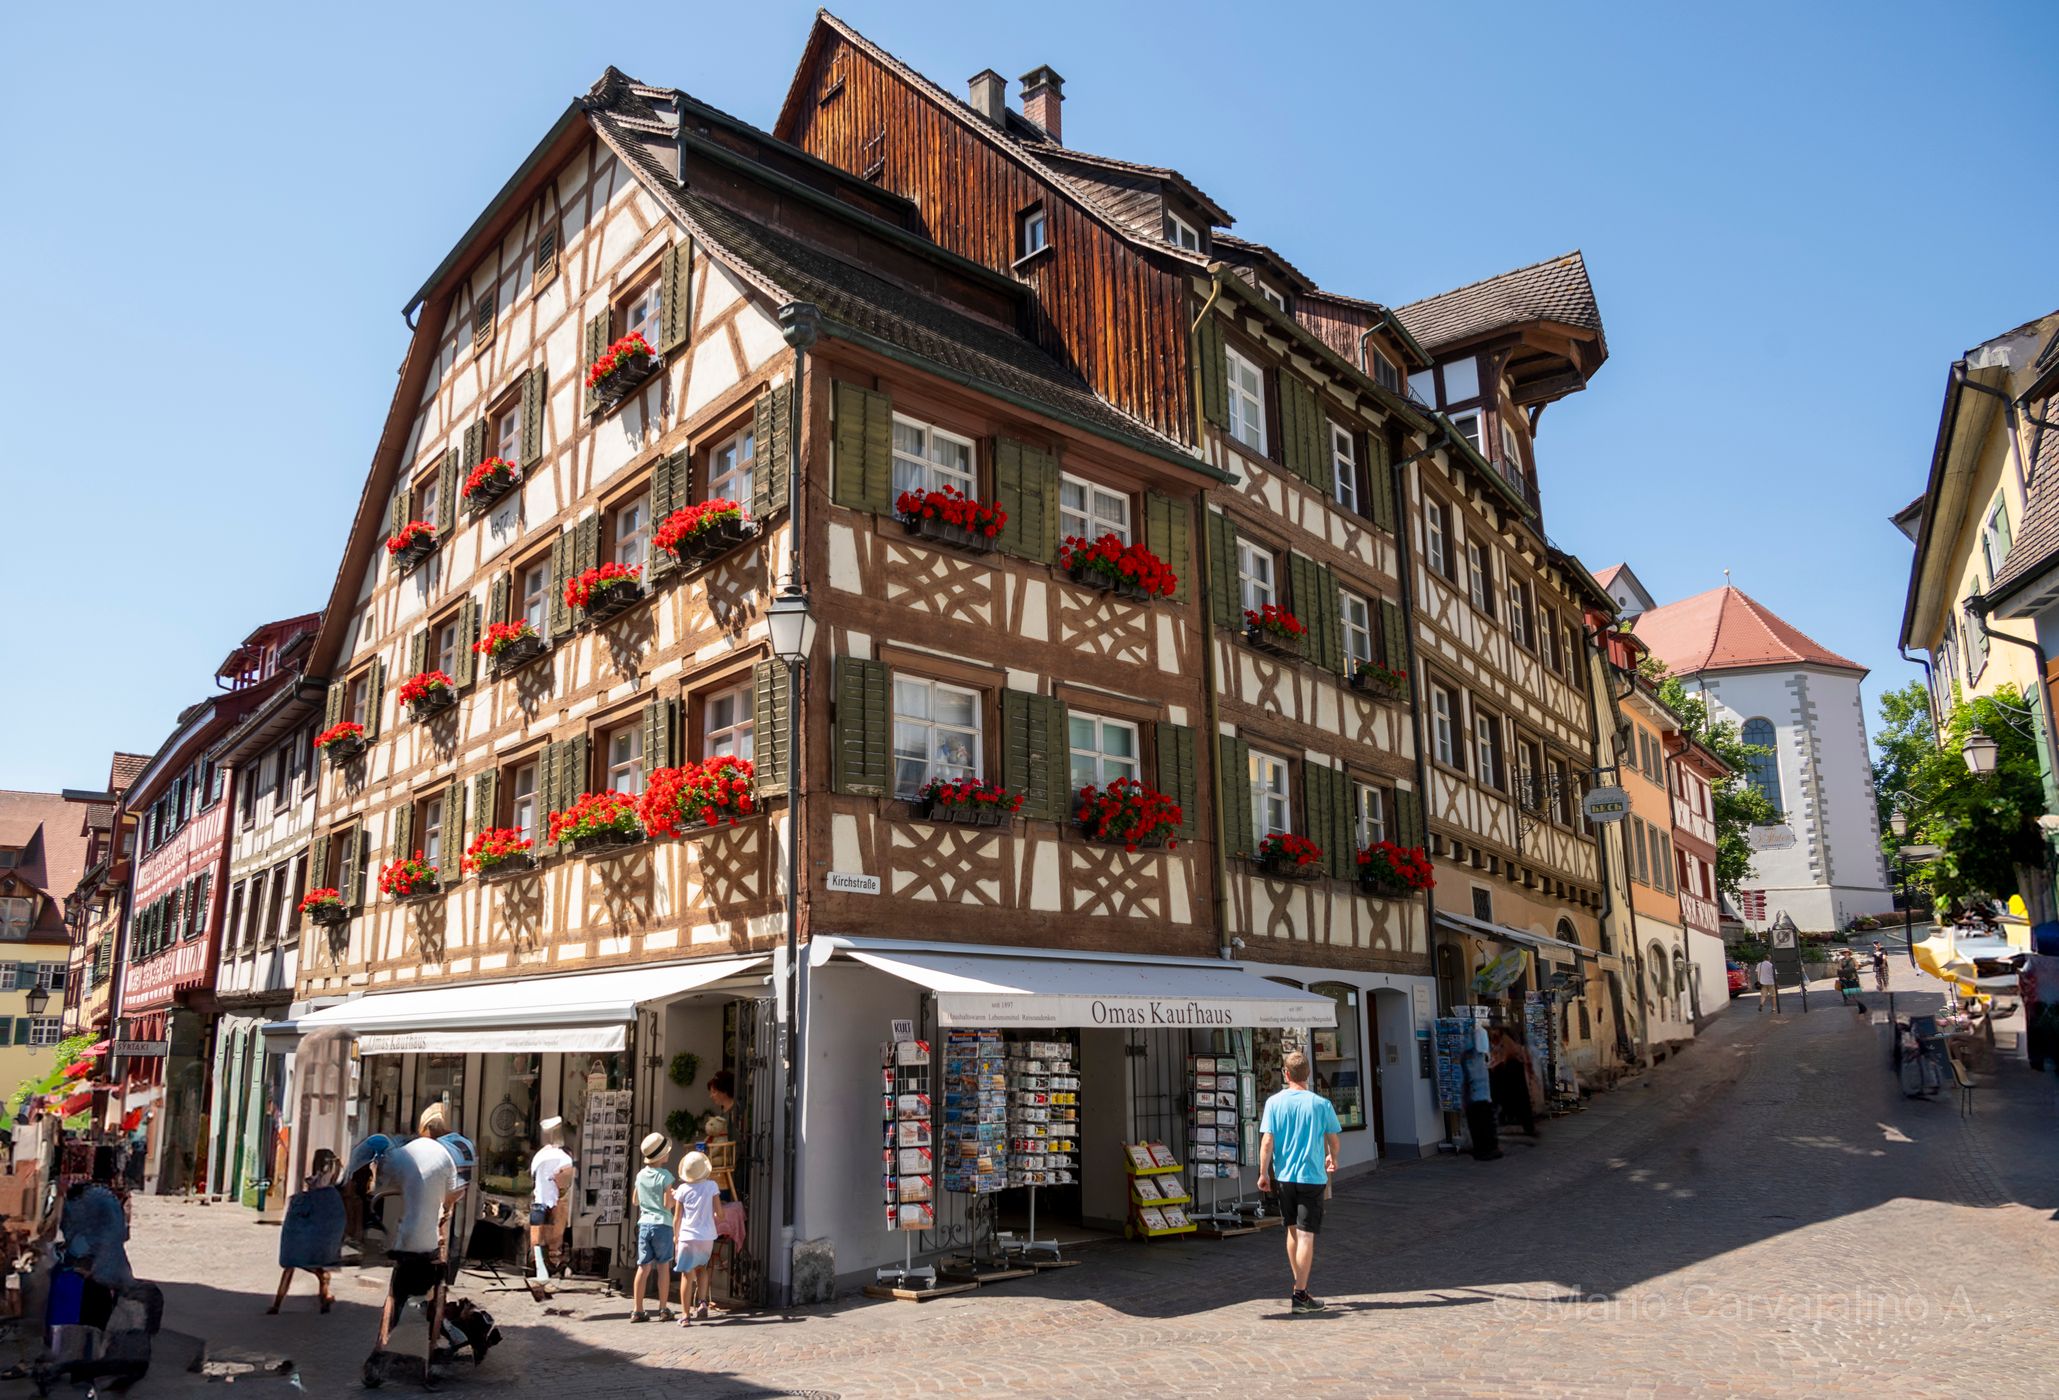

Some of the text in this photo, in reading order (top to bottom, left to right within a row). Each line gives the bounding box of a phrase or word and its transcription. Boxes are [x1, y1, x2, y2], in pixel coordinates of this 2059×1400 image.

[832, 875, 876, 889] Kirchstraße
[1092, 1001, 1232, 1024] Omas Kaufhaus
